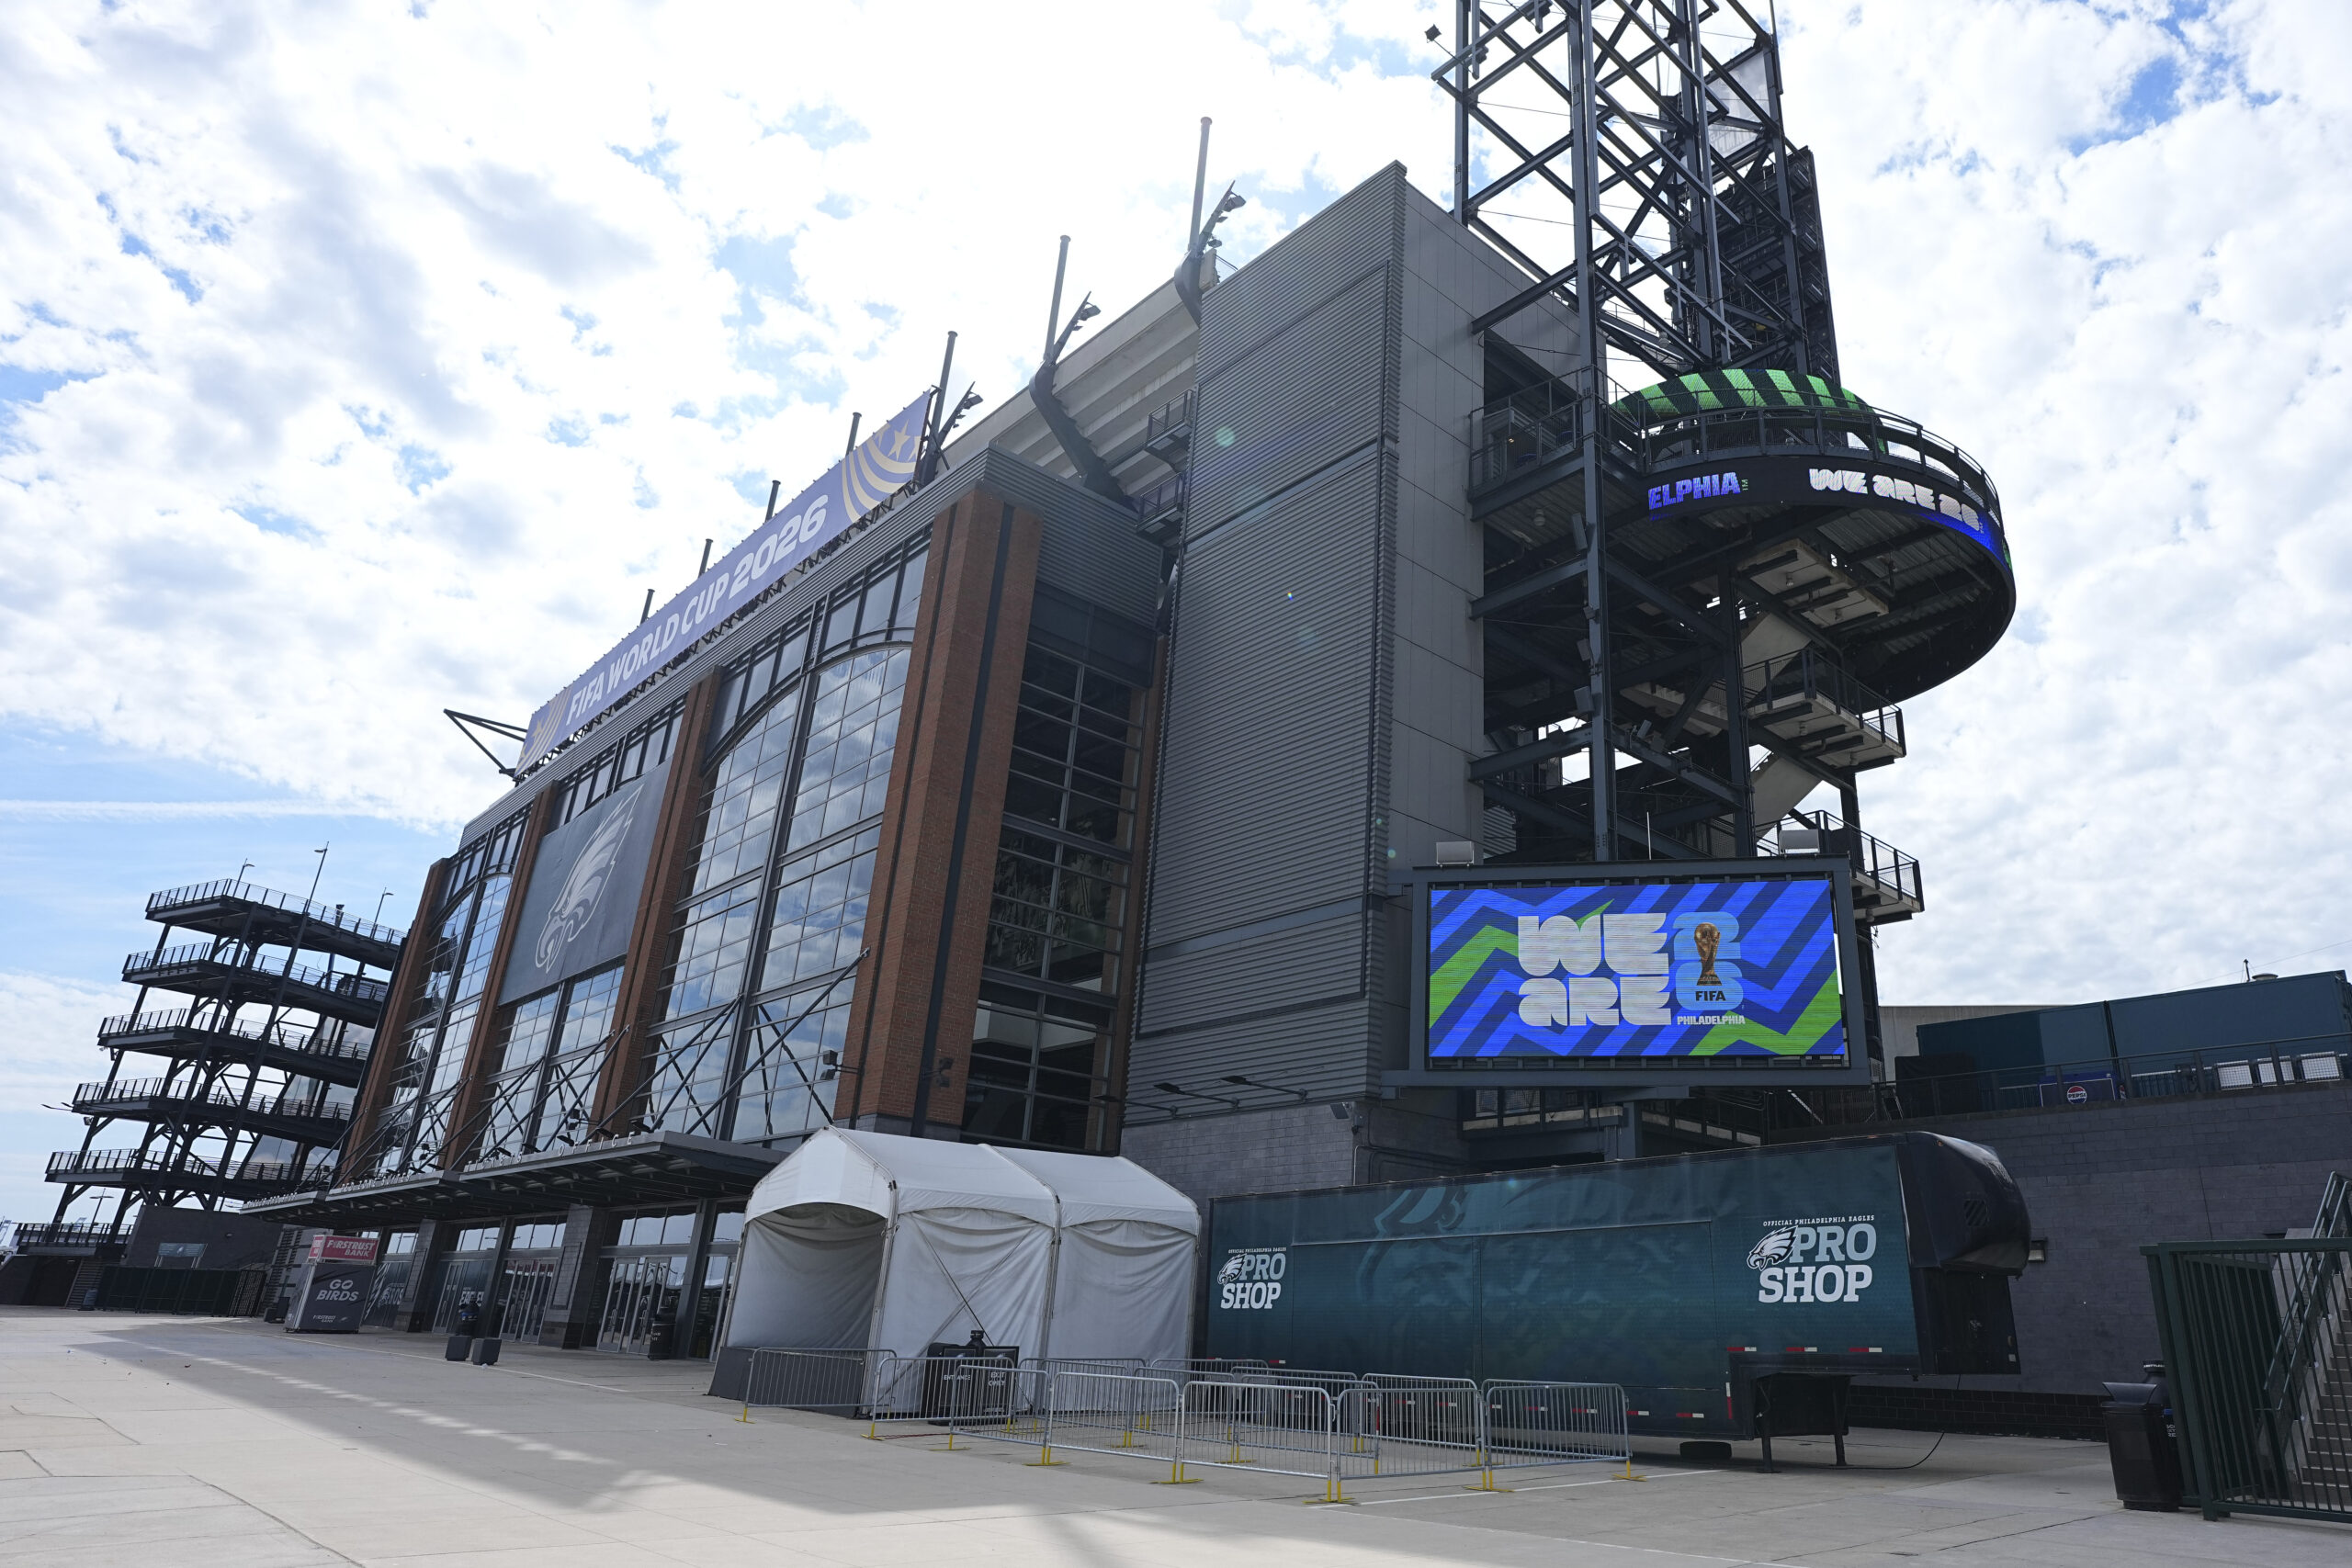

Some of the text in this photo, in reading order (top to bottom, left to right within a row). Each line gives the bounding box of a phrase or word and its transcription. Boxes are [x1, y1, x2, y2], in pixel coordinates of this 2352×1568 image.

[1648, 472, 1741, 510] ELPHIA
[1809, 468, 1868, 494] WE
[1872, 474, 1936, 511] ARE
[565, 494, 828, 727] FIFA WORLD CUP 2026
[1518, 912, 1669, 976] WE
[1518, 976, 1672, 1027] ARE
[1695, 990, 1726, 1001] FIFA
[1677, 1015, 1746, 1025] PHILADELPHIA
[558, 1131, 635, 1157] OFFICE
[1794, 1216, 1846, 1224] PHILADELPHIA
[1849, 1214, 1874, 1223] EAGLES
[345, 1249, 369, 1258] BANK
[1789, 1223, 1876, 1263] PRO
[1239, 1253, 1286, 1280] PRO
[316, 1290, 359, 1301] BIRDS
[329, 1279, 354, 1290] GO
[1221, 1282, 1282, 1309] SHOP
[1758, 1264, 1872, 1303] SHOP
